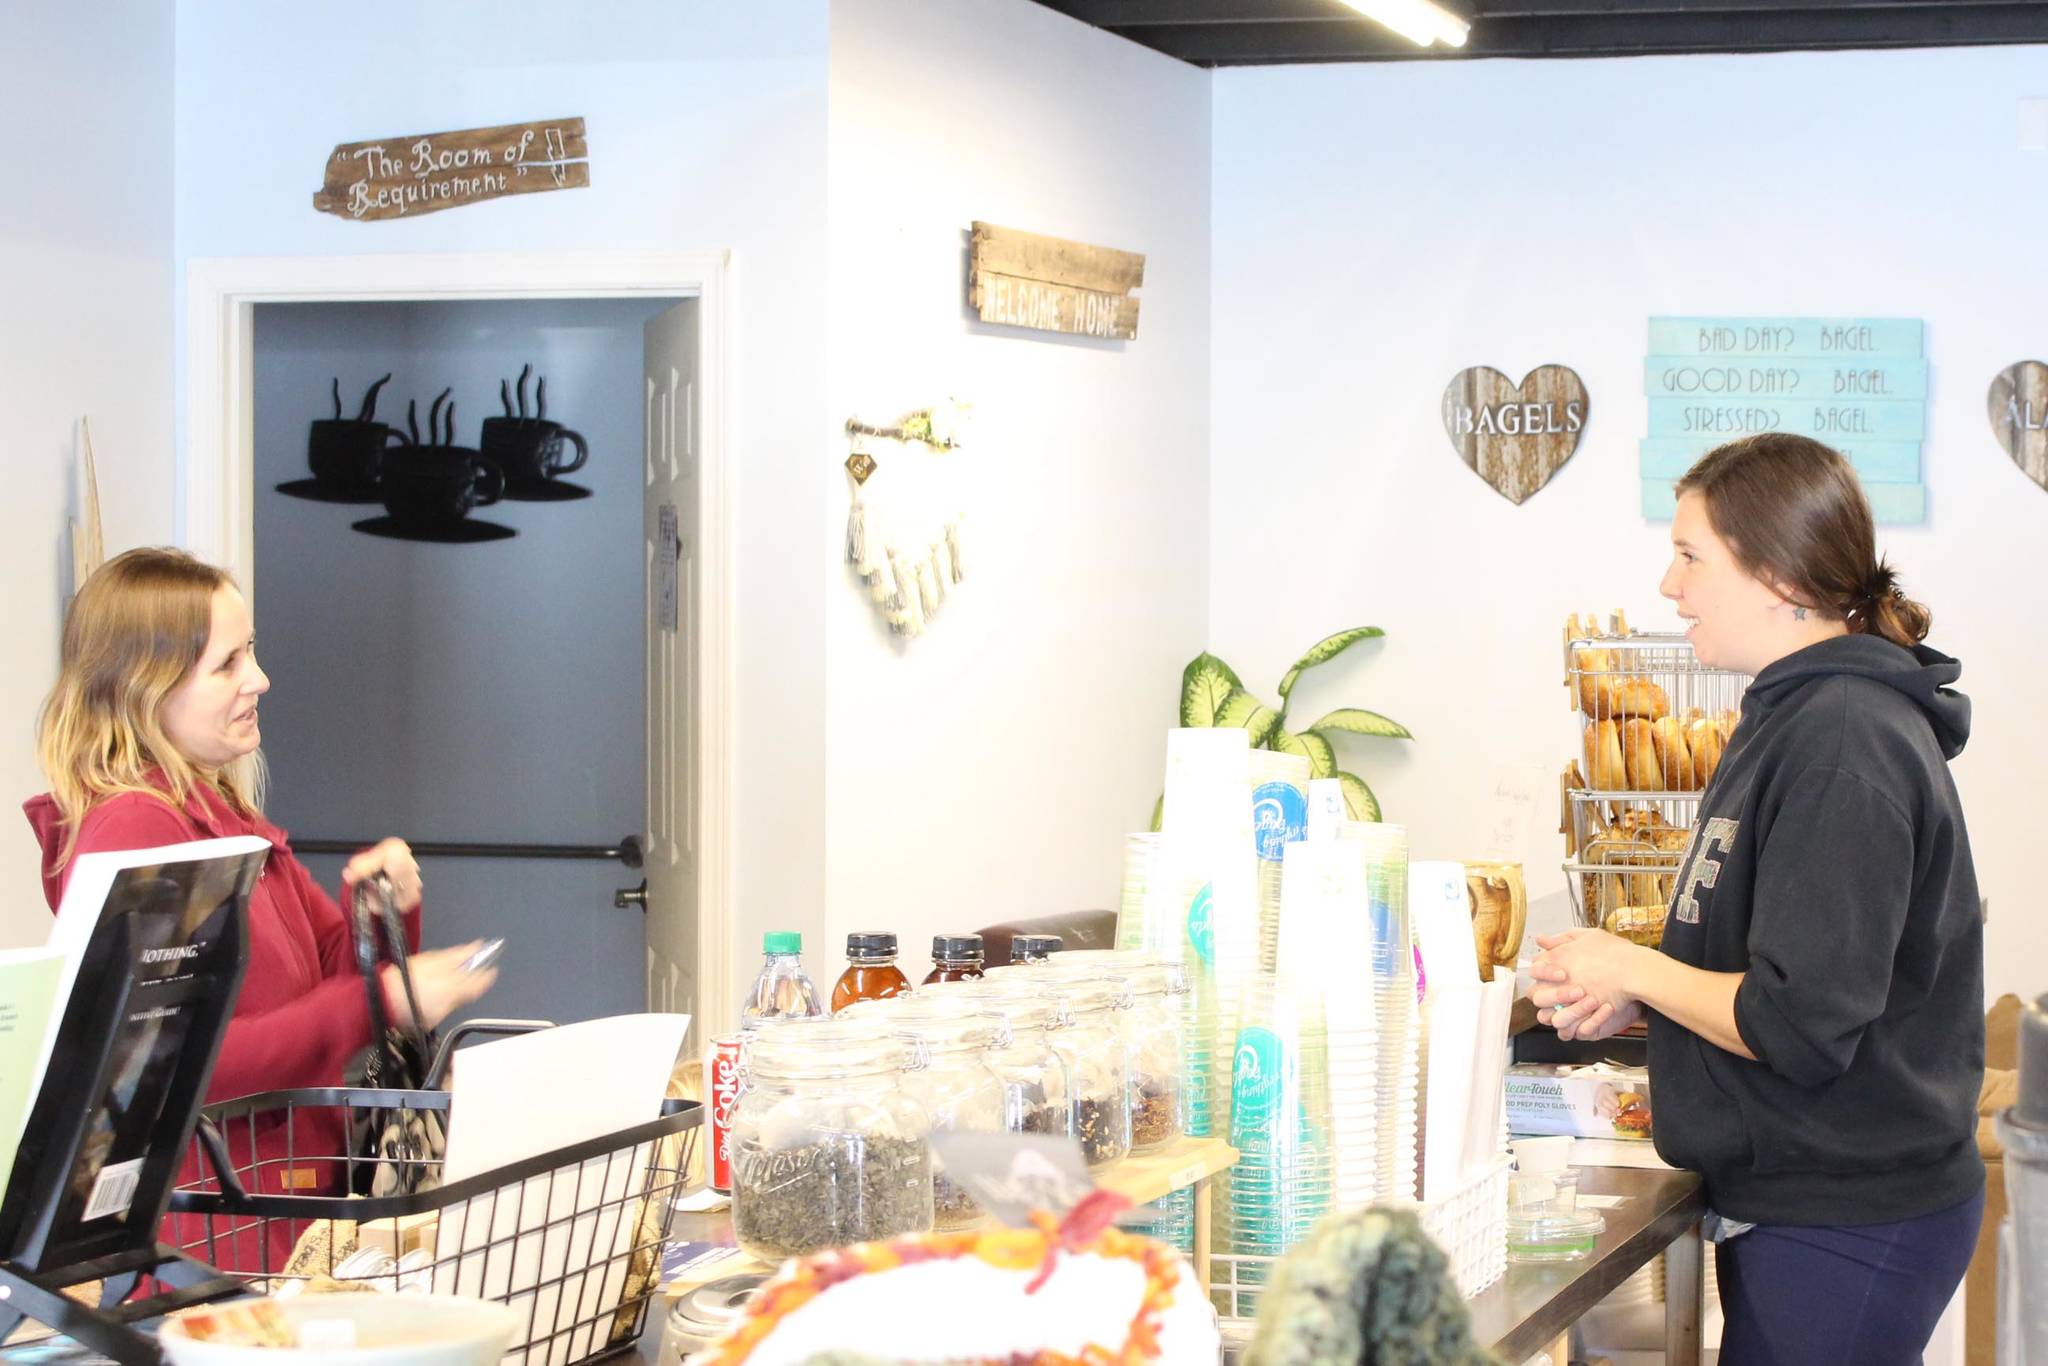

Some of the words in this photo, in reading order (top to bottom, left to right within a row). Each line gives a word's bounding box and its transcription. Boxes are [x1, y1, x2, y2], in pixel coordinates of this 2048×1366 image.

[410, 138, 492, 178] Room
[503, 129, 535, 162] of
[984, 275, 1061, 331] WELCOME
[1073, 291, 1120, 338] HOME
[1698, 327, 1737, 353] BAD
[1743, 327, 1795, 352] DAY?
[1662, 367, 1742, 393] GOOD
[1749, 368, 1800, 394] DAY?
[1455, 402, 1582, 435] BAGELS
[1682, 407, 1781, 433] STRESSED?
[714, 1059, 737, 1129] Coke
[1505, 1081, 1564, 1096] learTouch
[1516, 1100, 1534, 1109] PREP
[1534, 1101, 1551, 1110] POLY
[1551, 1102, 1577, 1111] GLOVES
